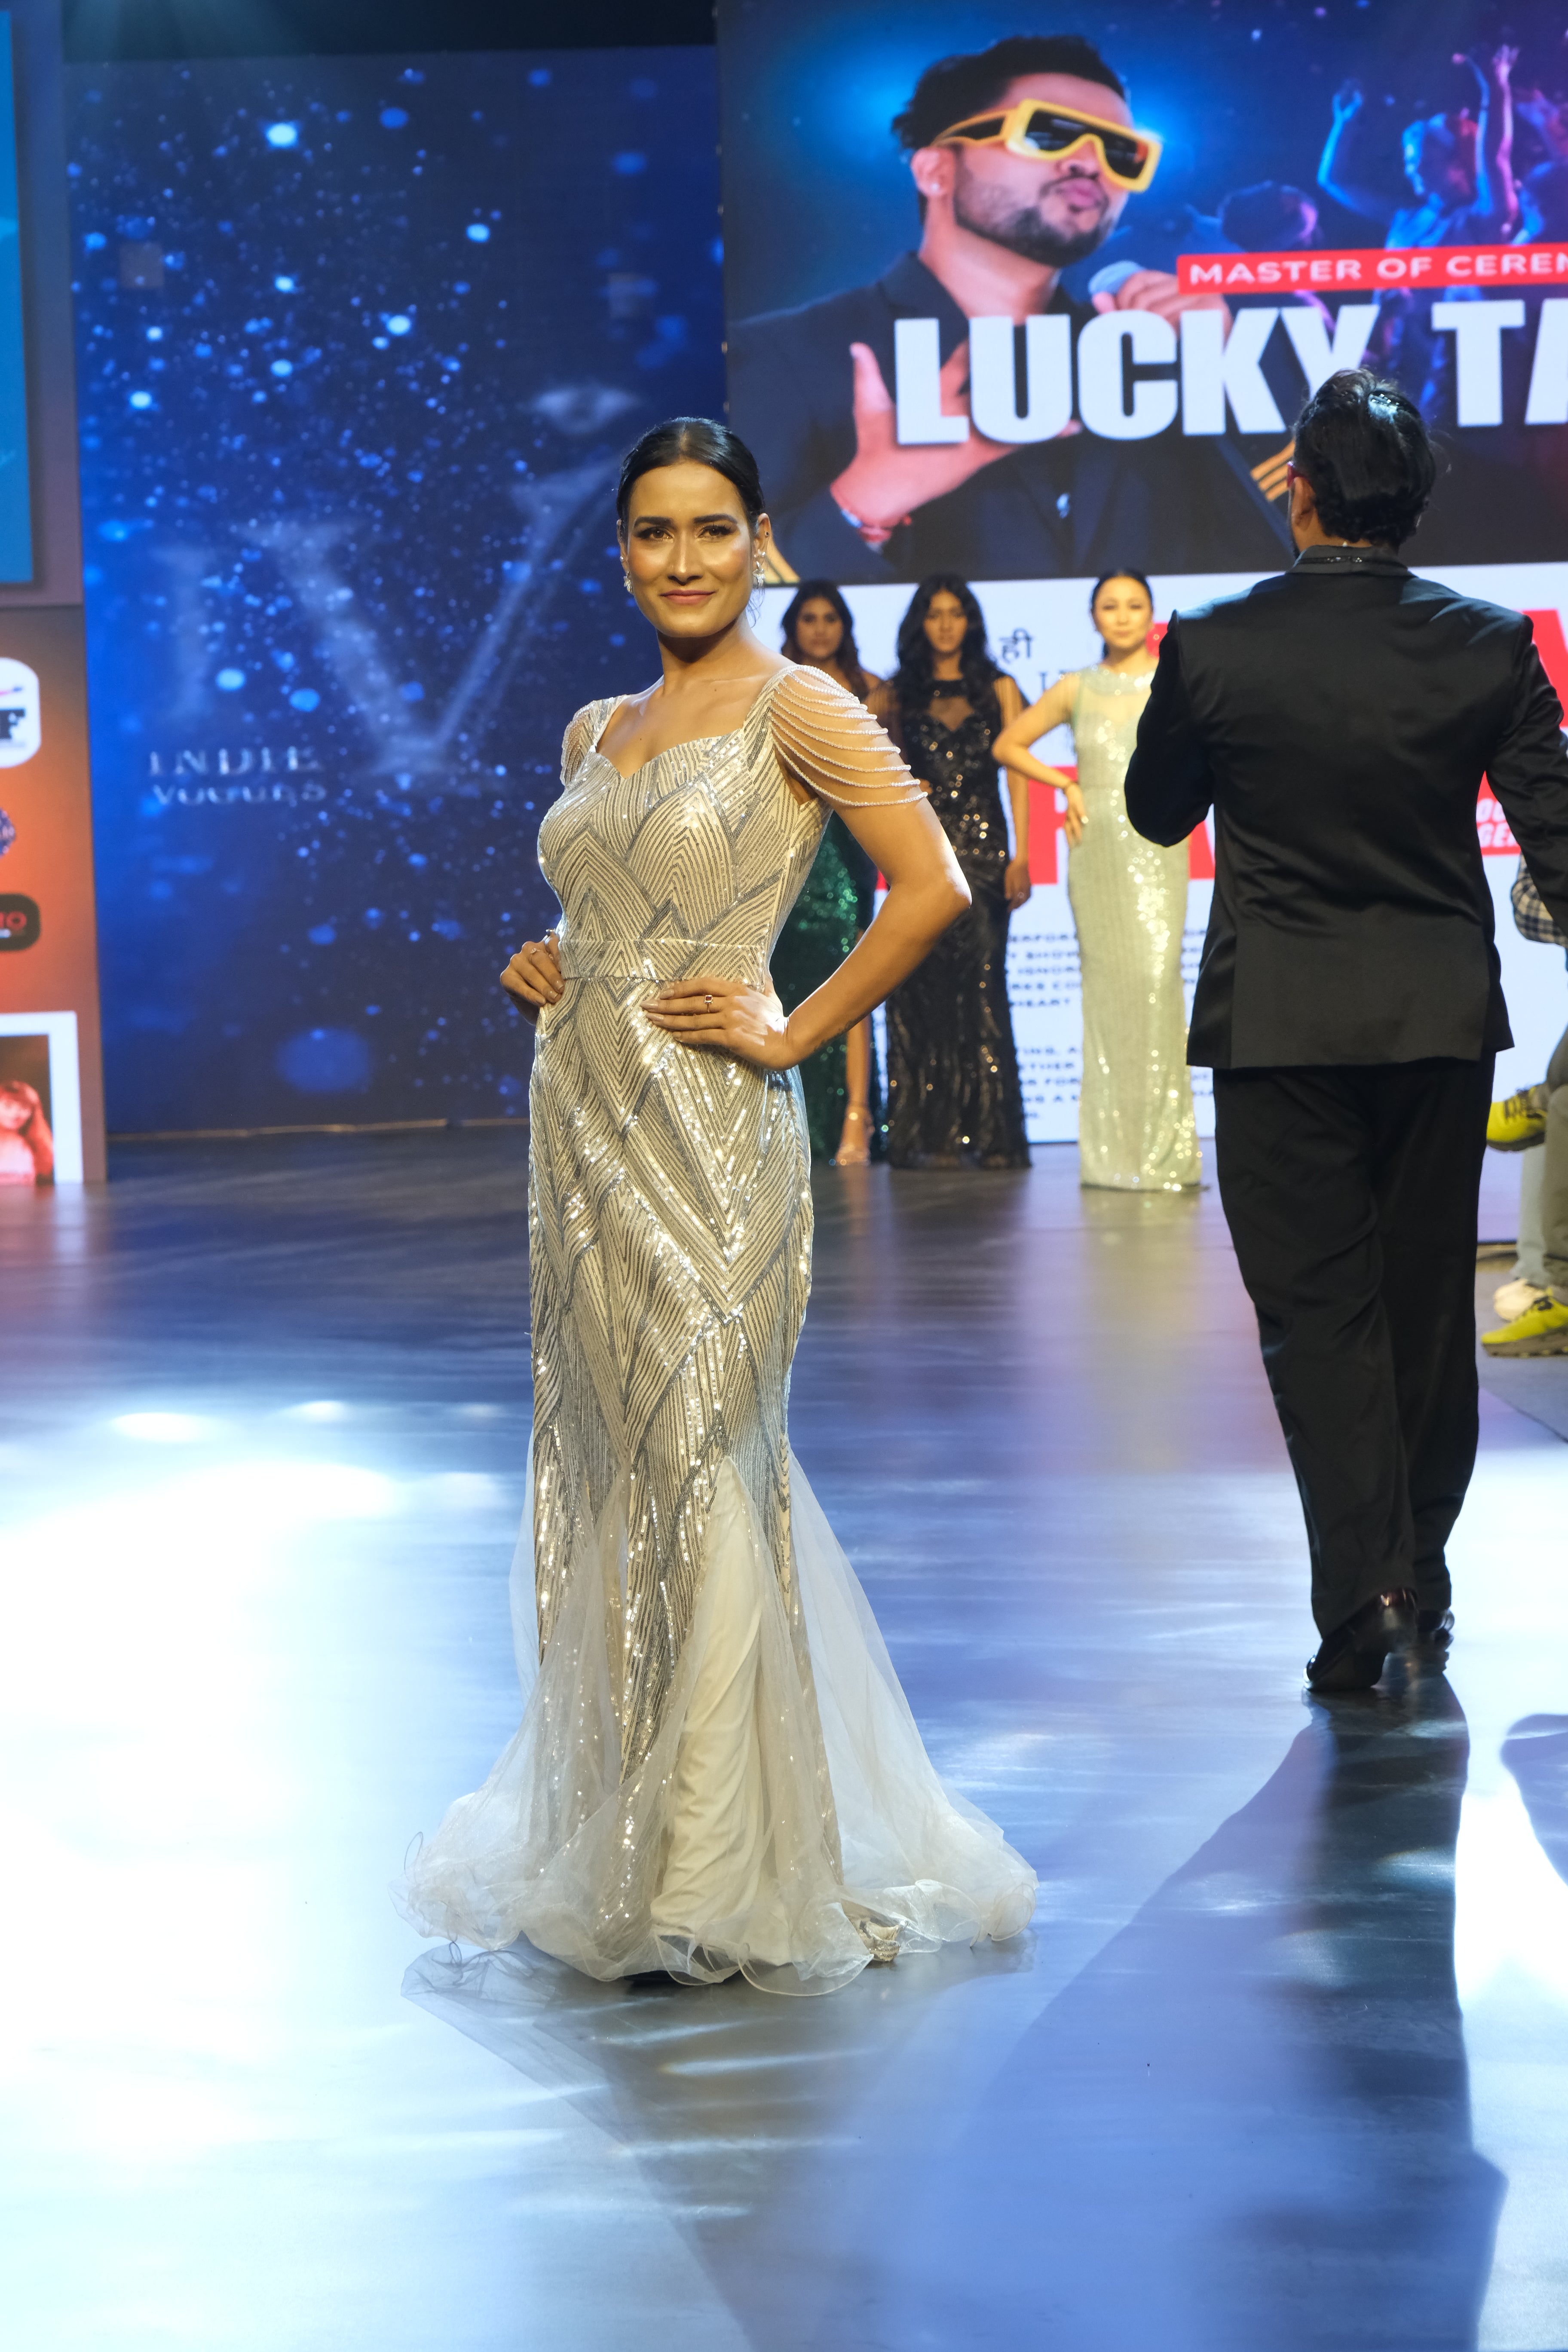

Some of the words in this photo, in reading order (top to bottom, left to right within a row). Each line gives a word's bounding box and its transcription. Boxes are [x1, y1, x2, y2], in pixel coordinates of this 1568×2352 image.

[1190, 259, 1362, 285] MASTER
[1377, 256, 1432, 280] OF
[894, 303, 1380, 444] LUCKY
